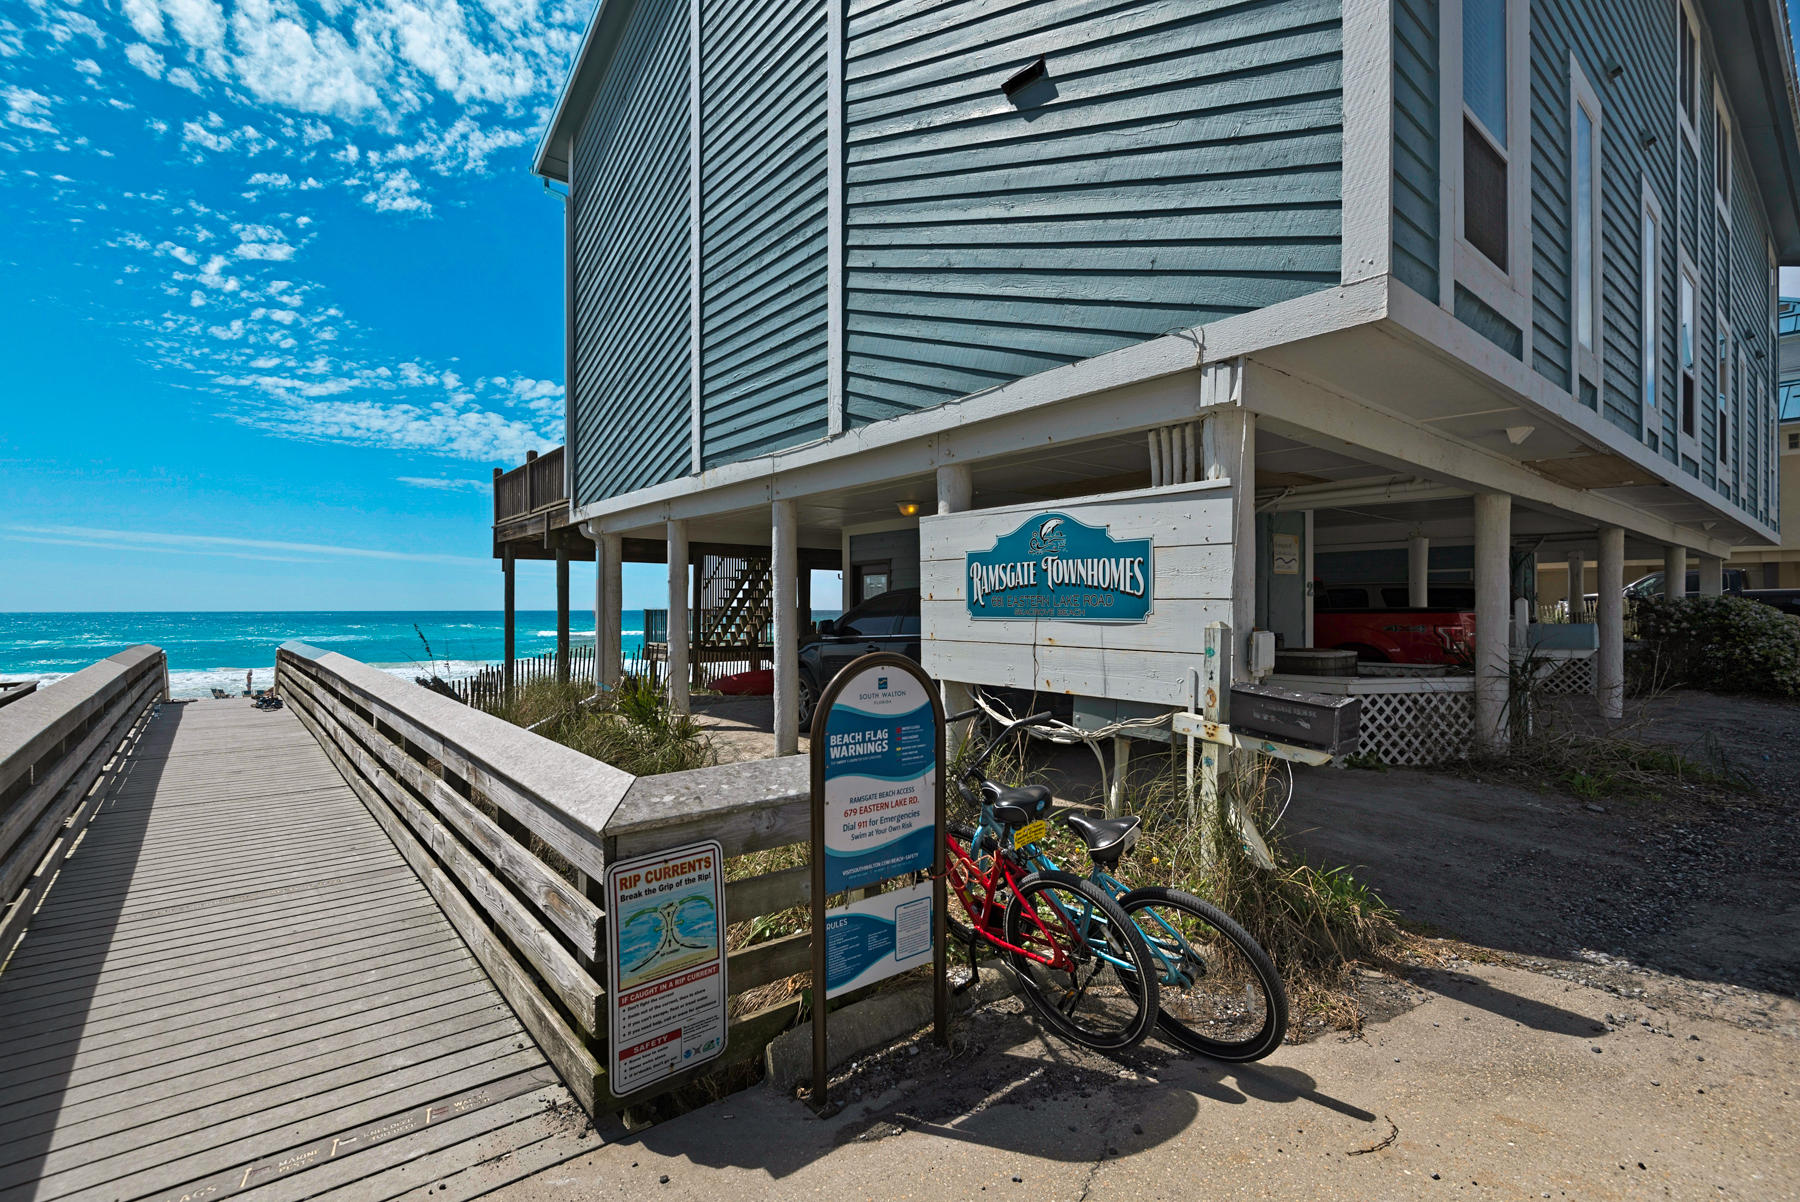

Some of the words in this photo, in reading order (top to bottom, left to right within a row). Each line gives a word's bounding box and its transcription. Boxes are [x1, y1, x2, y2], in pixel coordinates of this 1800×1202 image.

[970, 561, 1037, 607] RAMSGATE
[1041, 555, 1145, 599] TOWNHOMES
[1006, 594, 1050, 607] EASTERN
[1053, 594, 1081, 607] LAKE
[1083, 593, 1115, 607] ROAD
[1057, 608, 1086, 616] BEACH
[882, 690, 906, 698] WALTON
[830, 731, 862, 746] BEACH
[865, 729, 888, 741] FLAG
[830, 740, 888, 759] WARNINGS
[849, 793, 878, 804] RAMSGATE
[878, 789, 896, 799] BEACH
[897, 786, 915, 796] ACCESS
[843, 808, 858, 818] 679
[859, 802, 890, 815] EASTERN
[890, 799, 907, 809] LAKE
[908, 796, 920, 804] RD.
[842, 821, 857, 833] Dial
[857, 820, 868, 830] 911
[868, 818, 879, 827] for
[880, 810, 921, 824] Emergencies
[850, 833, 868, 841] Swim
[874, 827, 888, 835] Your
[888, 825, 901, 833] Own
[901, 822, 913, 830] Risk
[619, 873, 641, 891] RIP
[644, 856, 712, 884] CURRENTS
[620, 890, 643, 903] Break
[644, 886, 657, 896] the
[658, 882, 674, 892] Grip
[675, 878, 683, 887] of
[684, 876, 696, 885] the
[697, 871, 712, 881] Rip!
[621, 997, 629, 1005] IF
[630, 987, 658, 1001] CAUGHT
[674, 977, 687, 986] RIP
[687, 967, 717, 981] CURRENT
[633, 1034, 669, 1054] SAFETY
